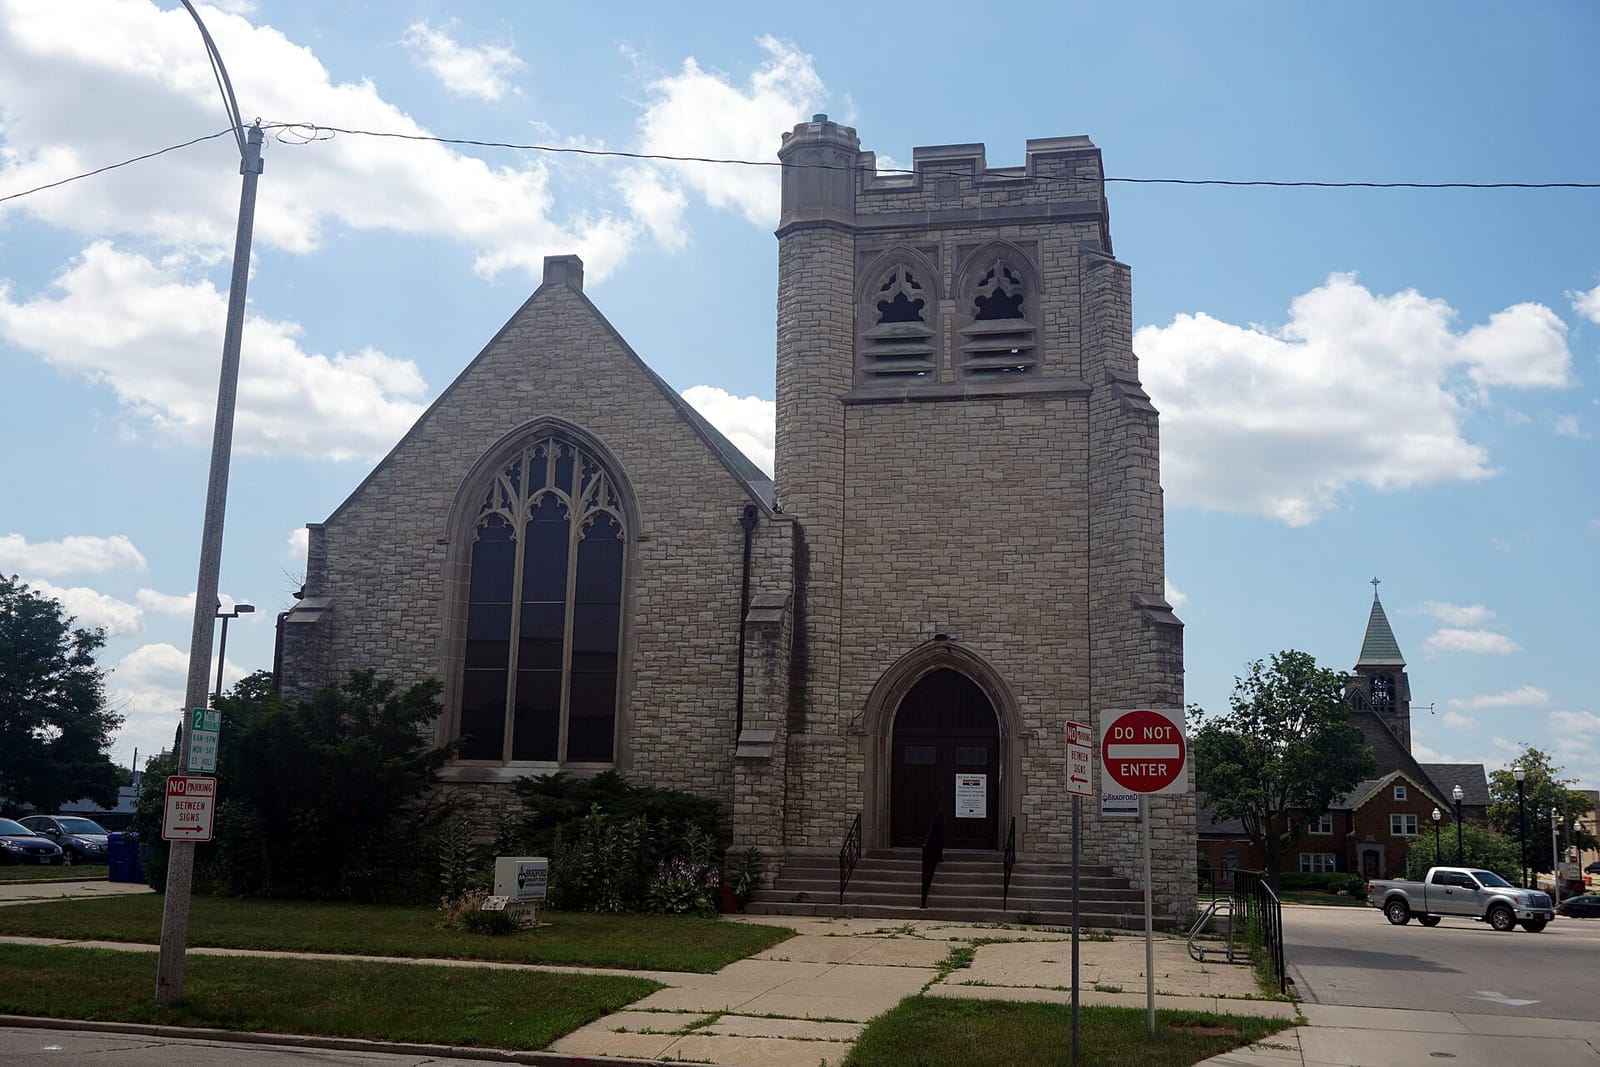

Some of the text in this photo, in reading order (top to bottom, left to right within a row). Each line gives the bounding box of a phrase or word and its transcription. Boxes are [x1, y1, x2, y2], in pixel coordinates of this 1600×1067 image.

[194, 711, 202, 728] 2
[1067, 726, 1076, 741] NO
[1115, 727, 1172, 739] DO NOT
[1071, 750, 1088, 762] BETWEEN
[1074, 763, 1086, 774] SIGNS
[1121, 763, 1167, 776] ENTER
[170, 781, 212, 793] NO PARKING
[1107, 793, 1138, 801] BRADFORD
[175, 801, 205, 811] BETWEEN
[179, 813, 200, 822] SIGNS
